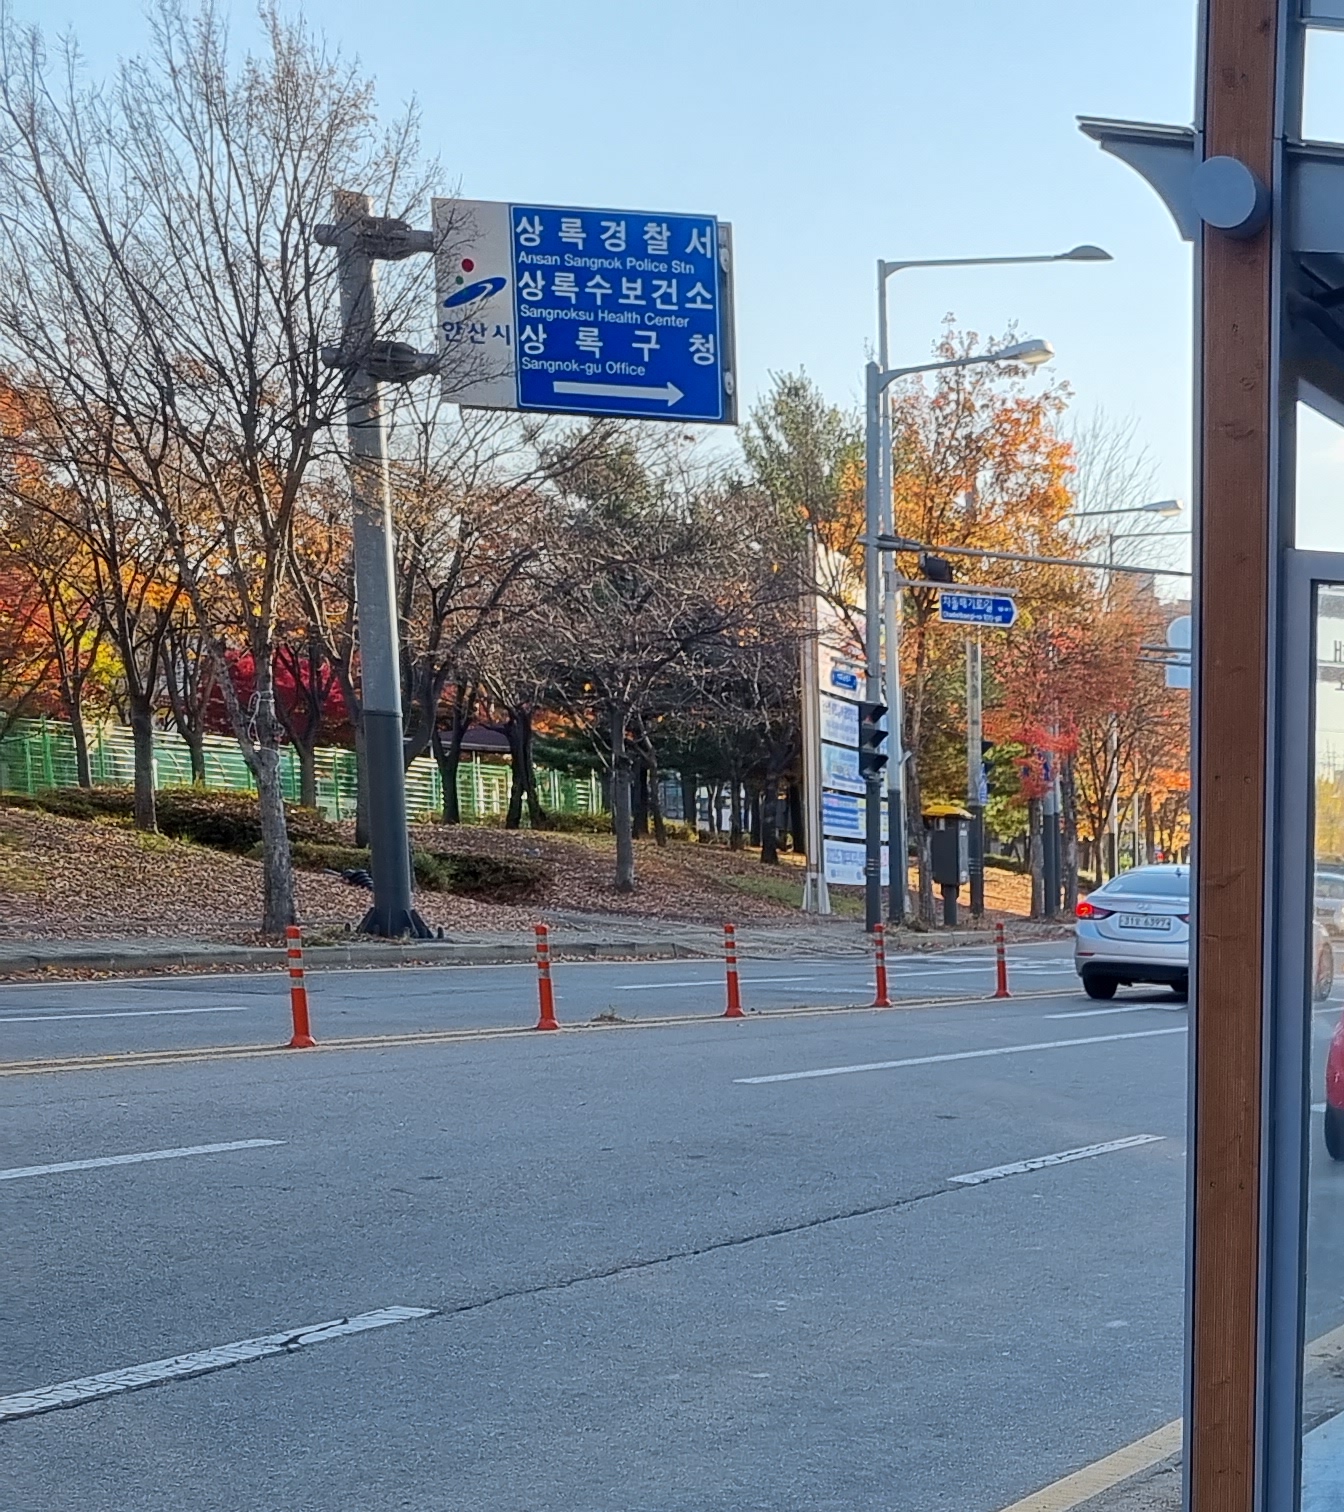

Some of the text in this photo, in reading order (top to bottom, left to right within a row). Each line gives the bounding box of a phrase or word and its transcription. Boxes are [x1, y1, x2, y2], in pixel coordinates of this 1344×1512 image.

[515, 214, 713, 260] 상록경찰서
[517, 250, 695, 275] Ansan Sangnok Police Stn
[517, 269, 714, 312] 상록수보건소
[520, 305, 690, 328] Sangnoksu Health Center
[441, 321, 511, 346] 안산시
[519, 323, 716, 366] 상록구청
[521, 356, 646, 376] Sangnok-gu Office
